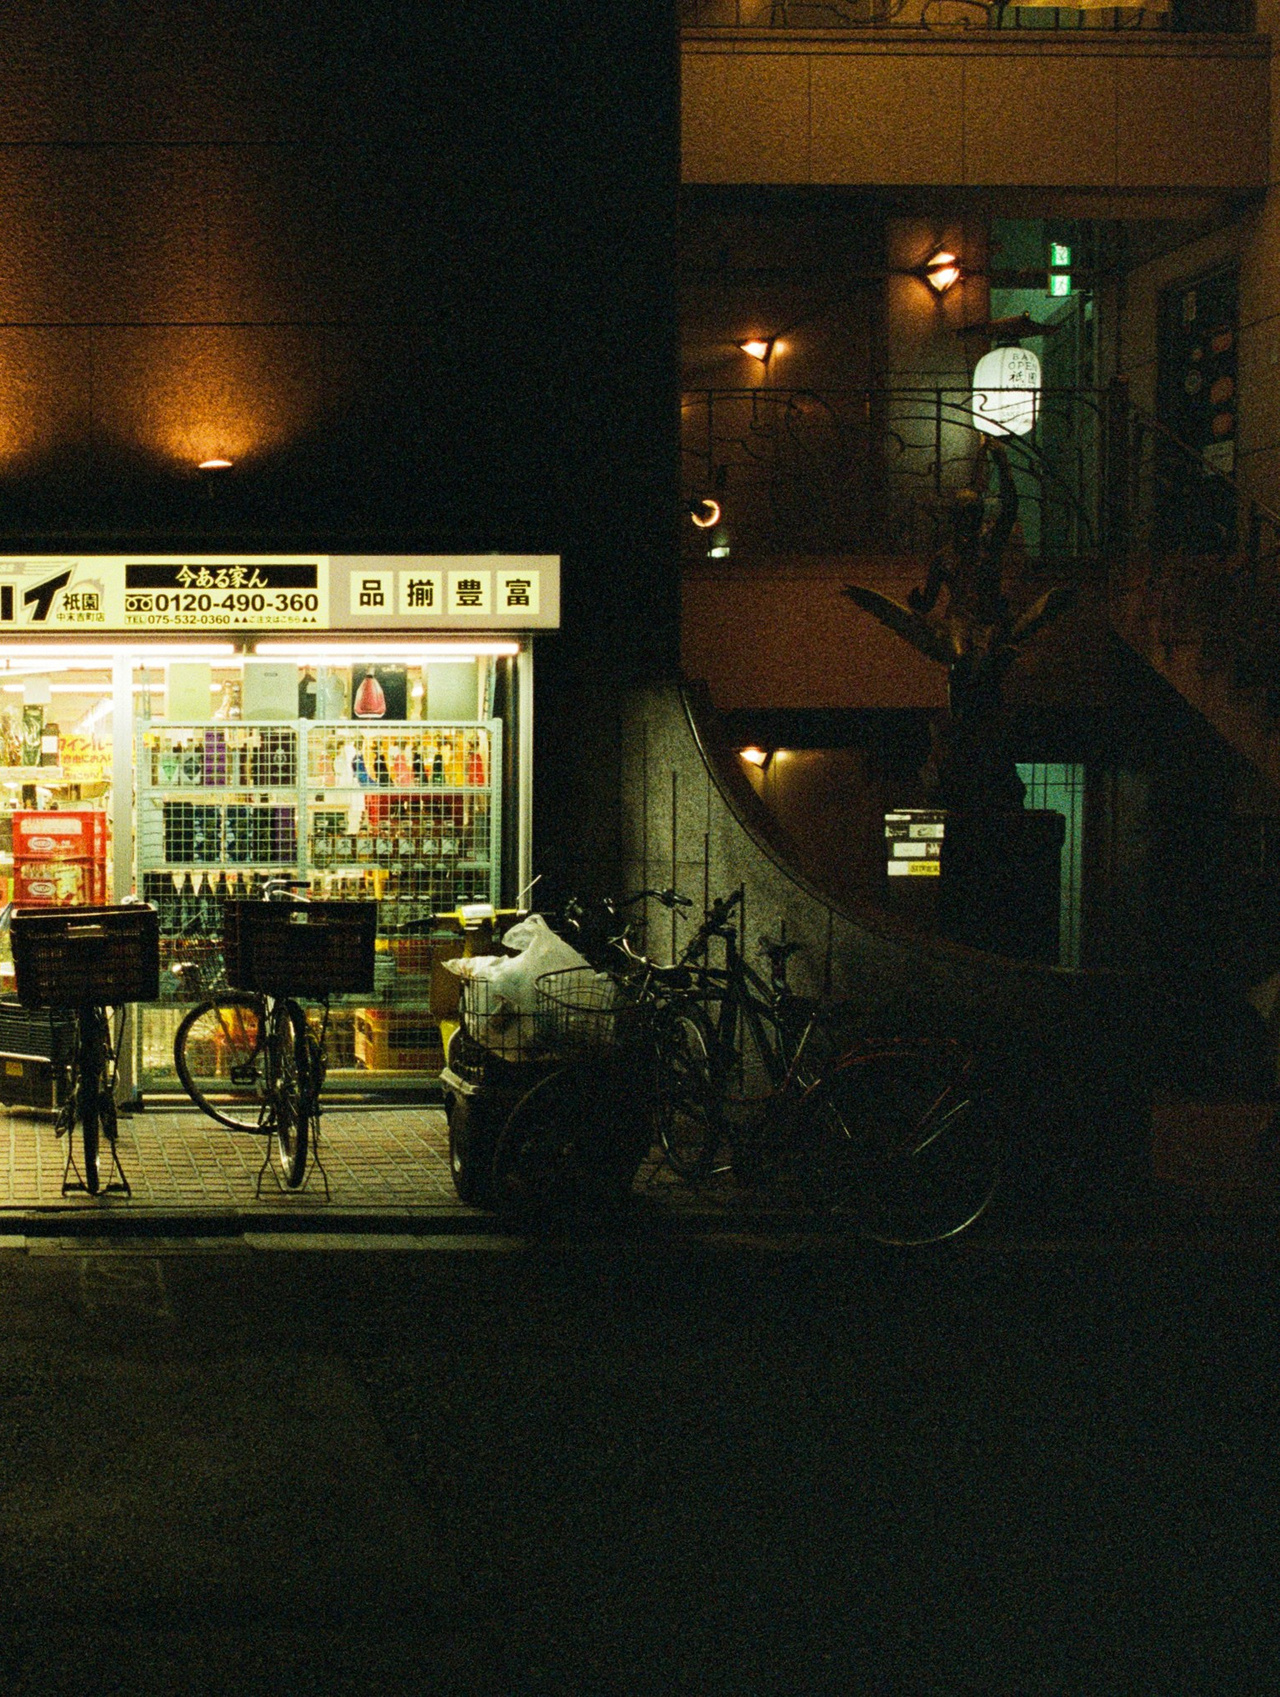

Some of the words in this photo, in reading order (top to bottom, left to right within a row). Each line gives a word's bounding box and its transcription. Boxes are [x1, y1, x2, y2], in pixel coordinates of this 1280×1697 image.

[176, 565, 269, 588] 今ある家ん
[62, 593, 99, 611] 祇園
[359, 579, 531, 607] 品揃豊富
[155, 594, 318, 612] 0120-490-360
[148, 615, 230, 625] 075-532-0360
